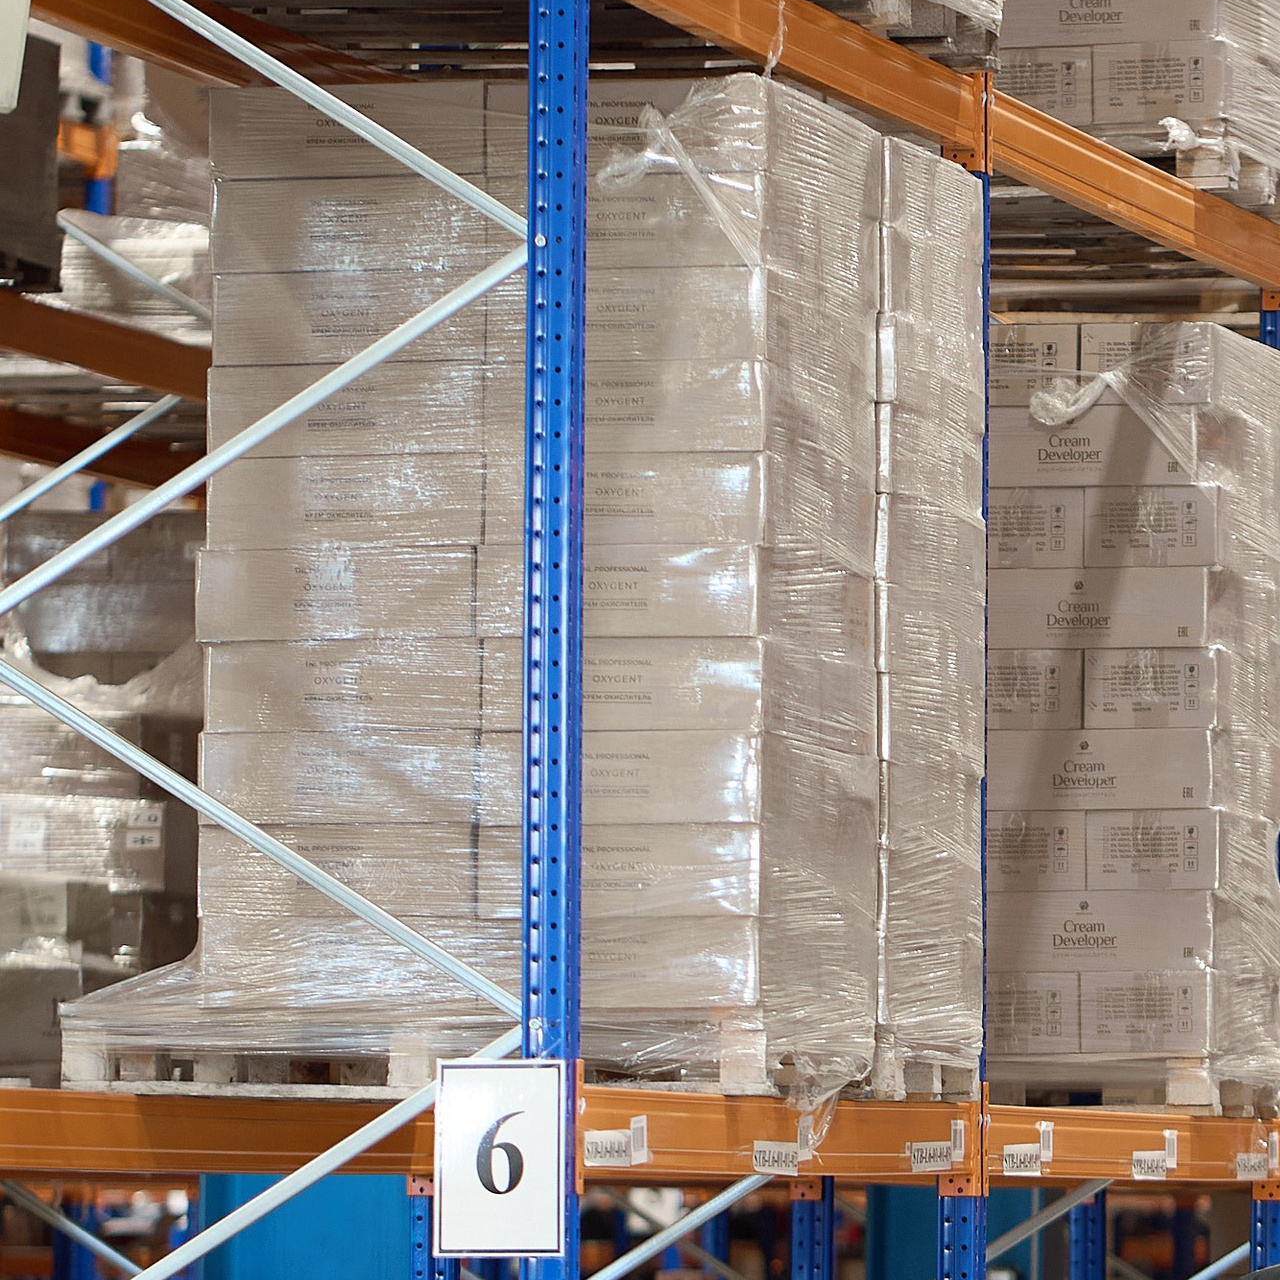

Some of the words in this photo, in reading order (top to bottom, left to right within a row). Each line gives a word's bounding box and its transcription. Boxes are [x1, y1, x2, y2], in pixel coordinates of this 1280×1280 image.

[1058, 10, 1124, 24] Developer
[596, 211, 647, 221] OXYGENT
[596, 303, 648, 313] OXYGENT
[595, 396, 646, 406] OXYGENT
[1048, 433, 1091, 447] Cream
[1037, 448, 1102, 463] Developer
[588, 581, 639, 591] OXYGENT
[1057, 599, 1100, 613] Cream
[1045, 614, 1111, 629] Developer
[592, 674, 644, 684] OXYGENT
[590, 768, 641, 778] OXYGENT
[1062, 759, 1106, 773] Cream
[1052, 774, 1117, 789] Developer
[1062, 919, 1106, 933] Cream
[1052, 934, 1118, 949] Developer
[588, 951, 638, 961] OXYGENT
[475, 1110, 526, 1195] 6
